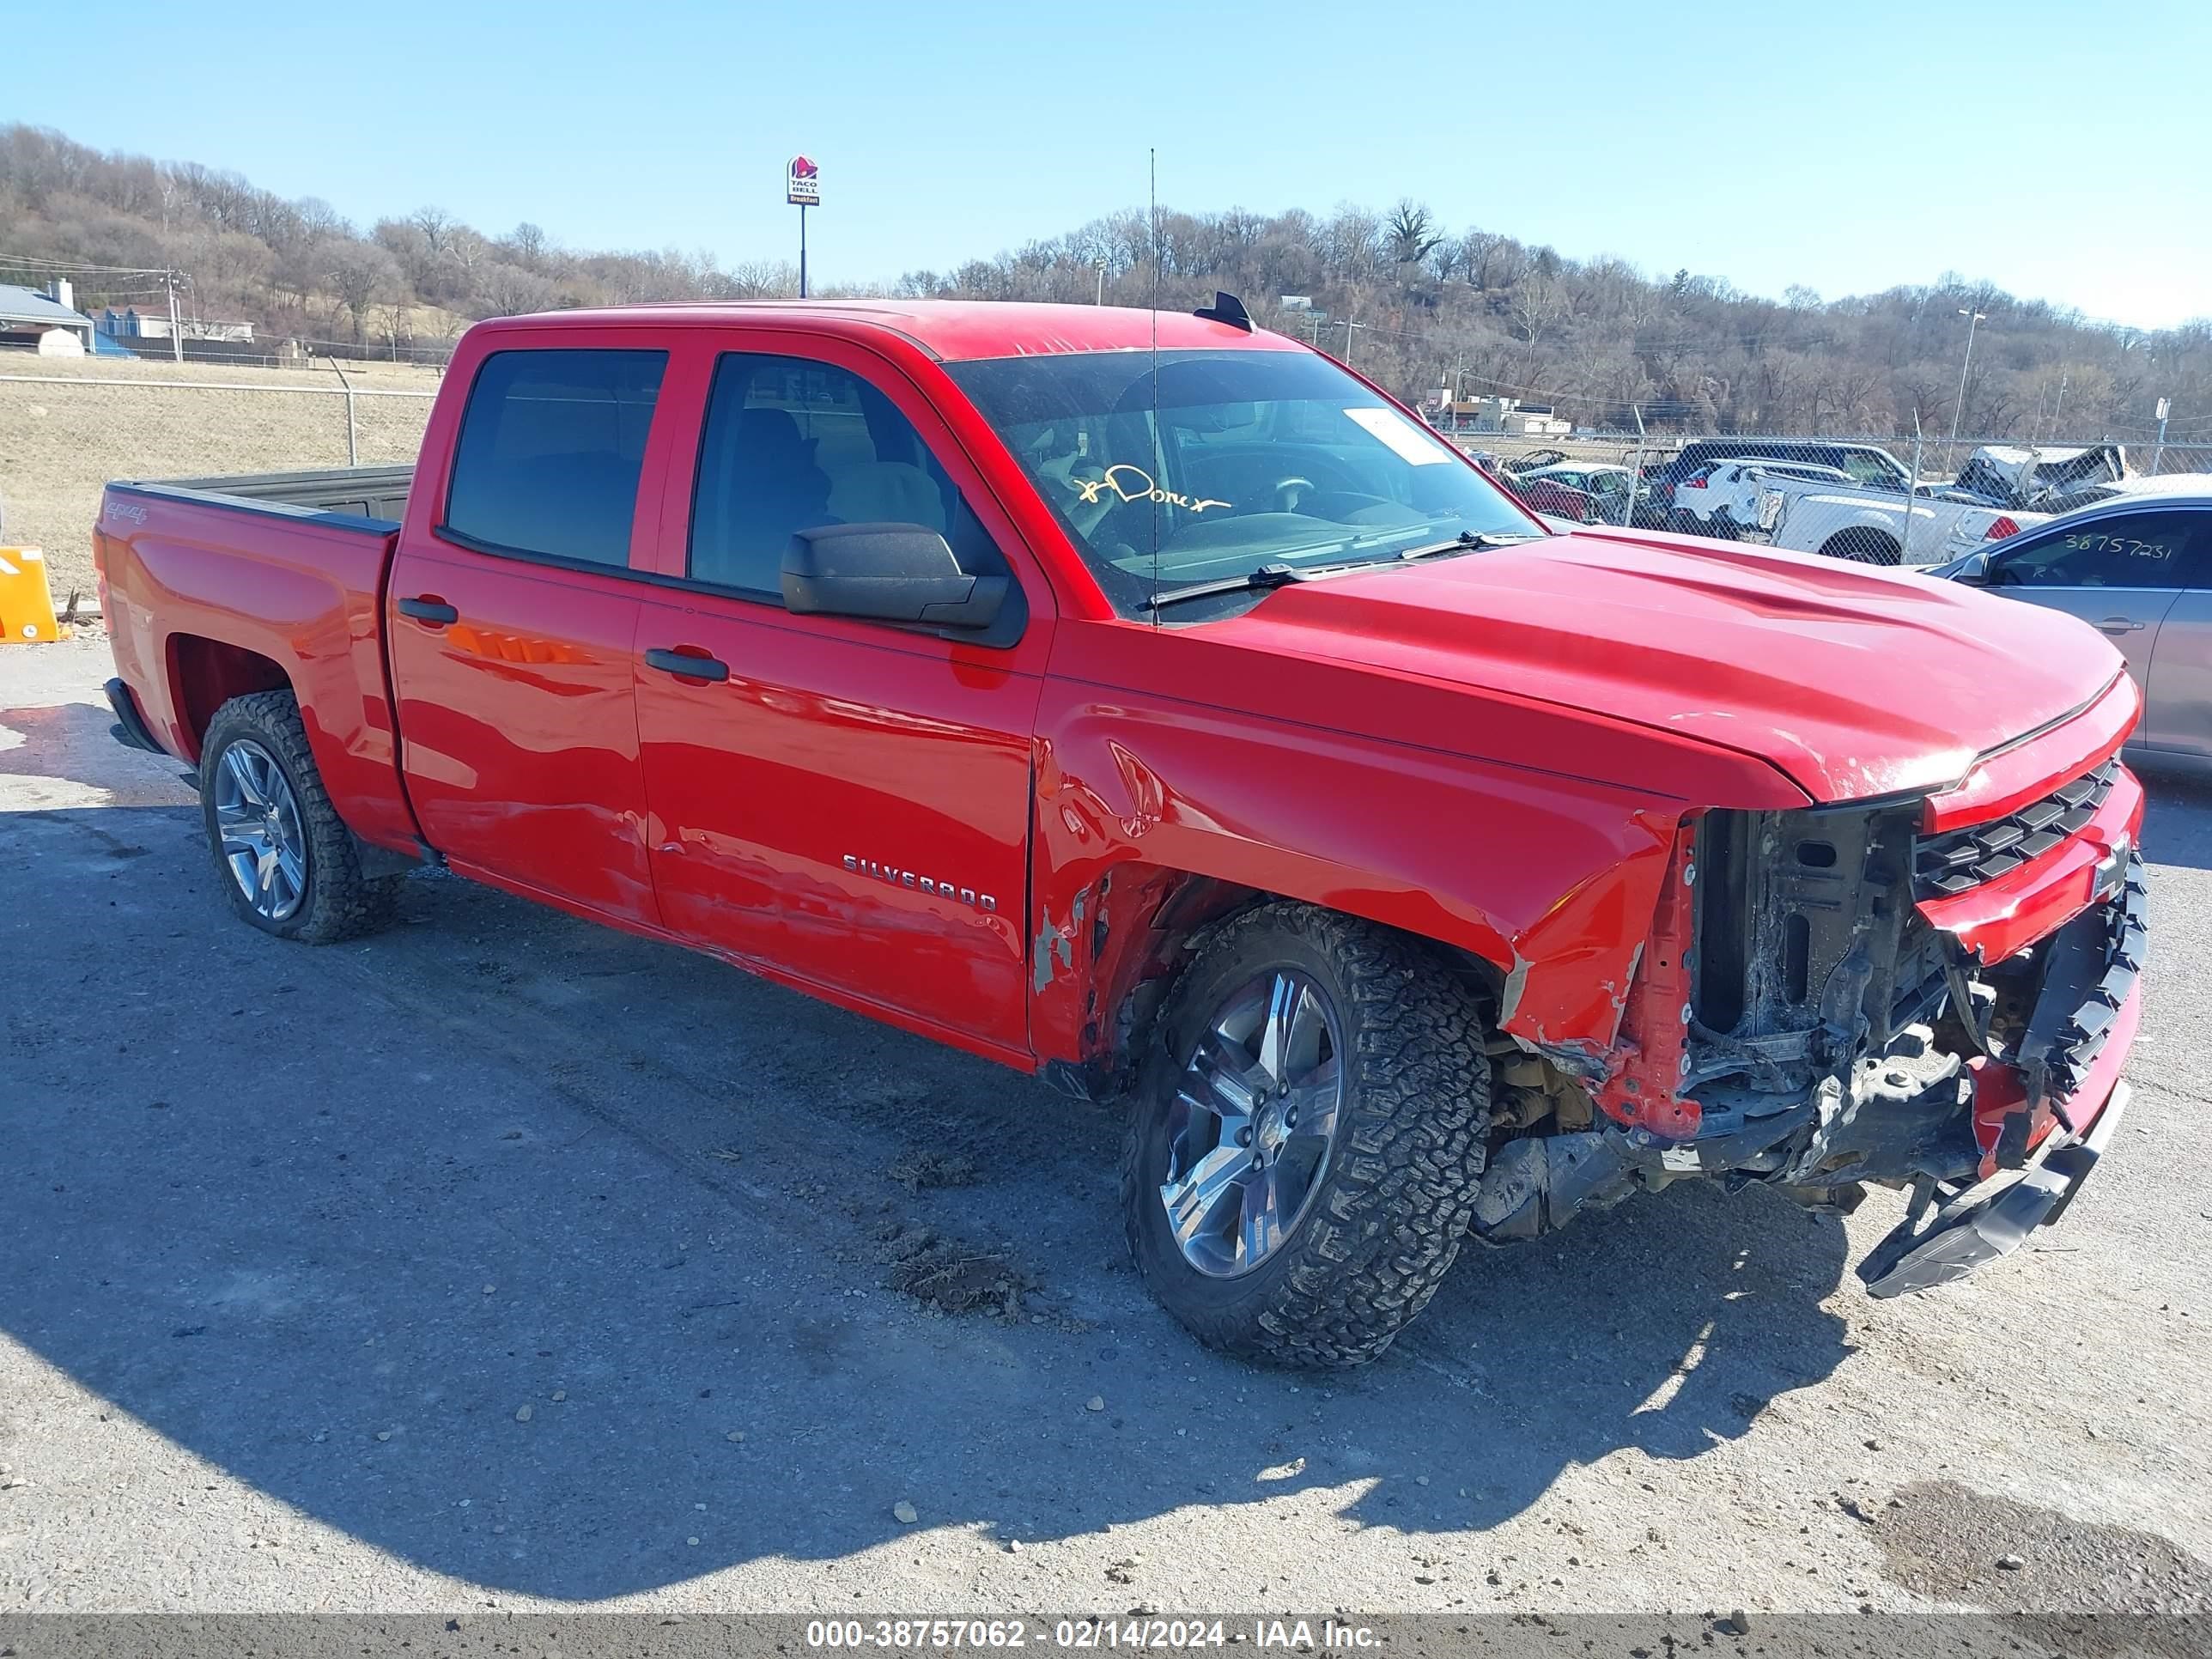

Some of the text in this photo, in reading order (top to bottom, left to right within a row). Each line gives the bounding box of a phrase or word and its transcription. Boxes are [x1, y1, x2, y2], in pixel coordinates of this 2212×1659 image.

[790, 195, 818, 204] Breakfast
[2064, 534, 2172, 561] 38757231
[842, 854, 997, 912] SILVERADO
